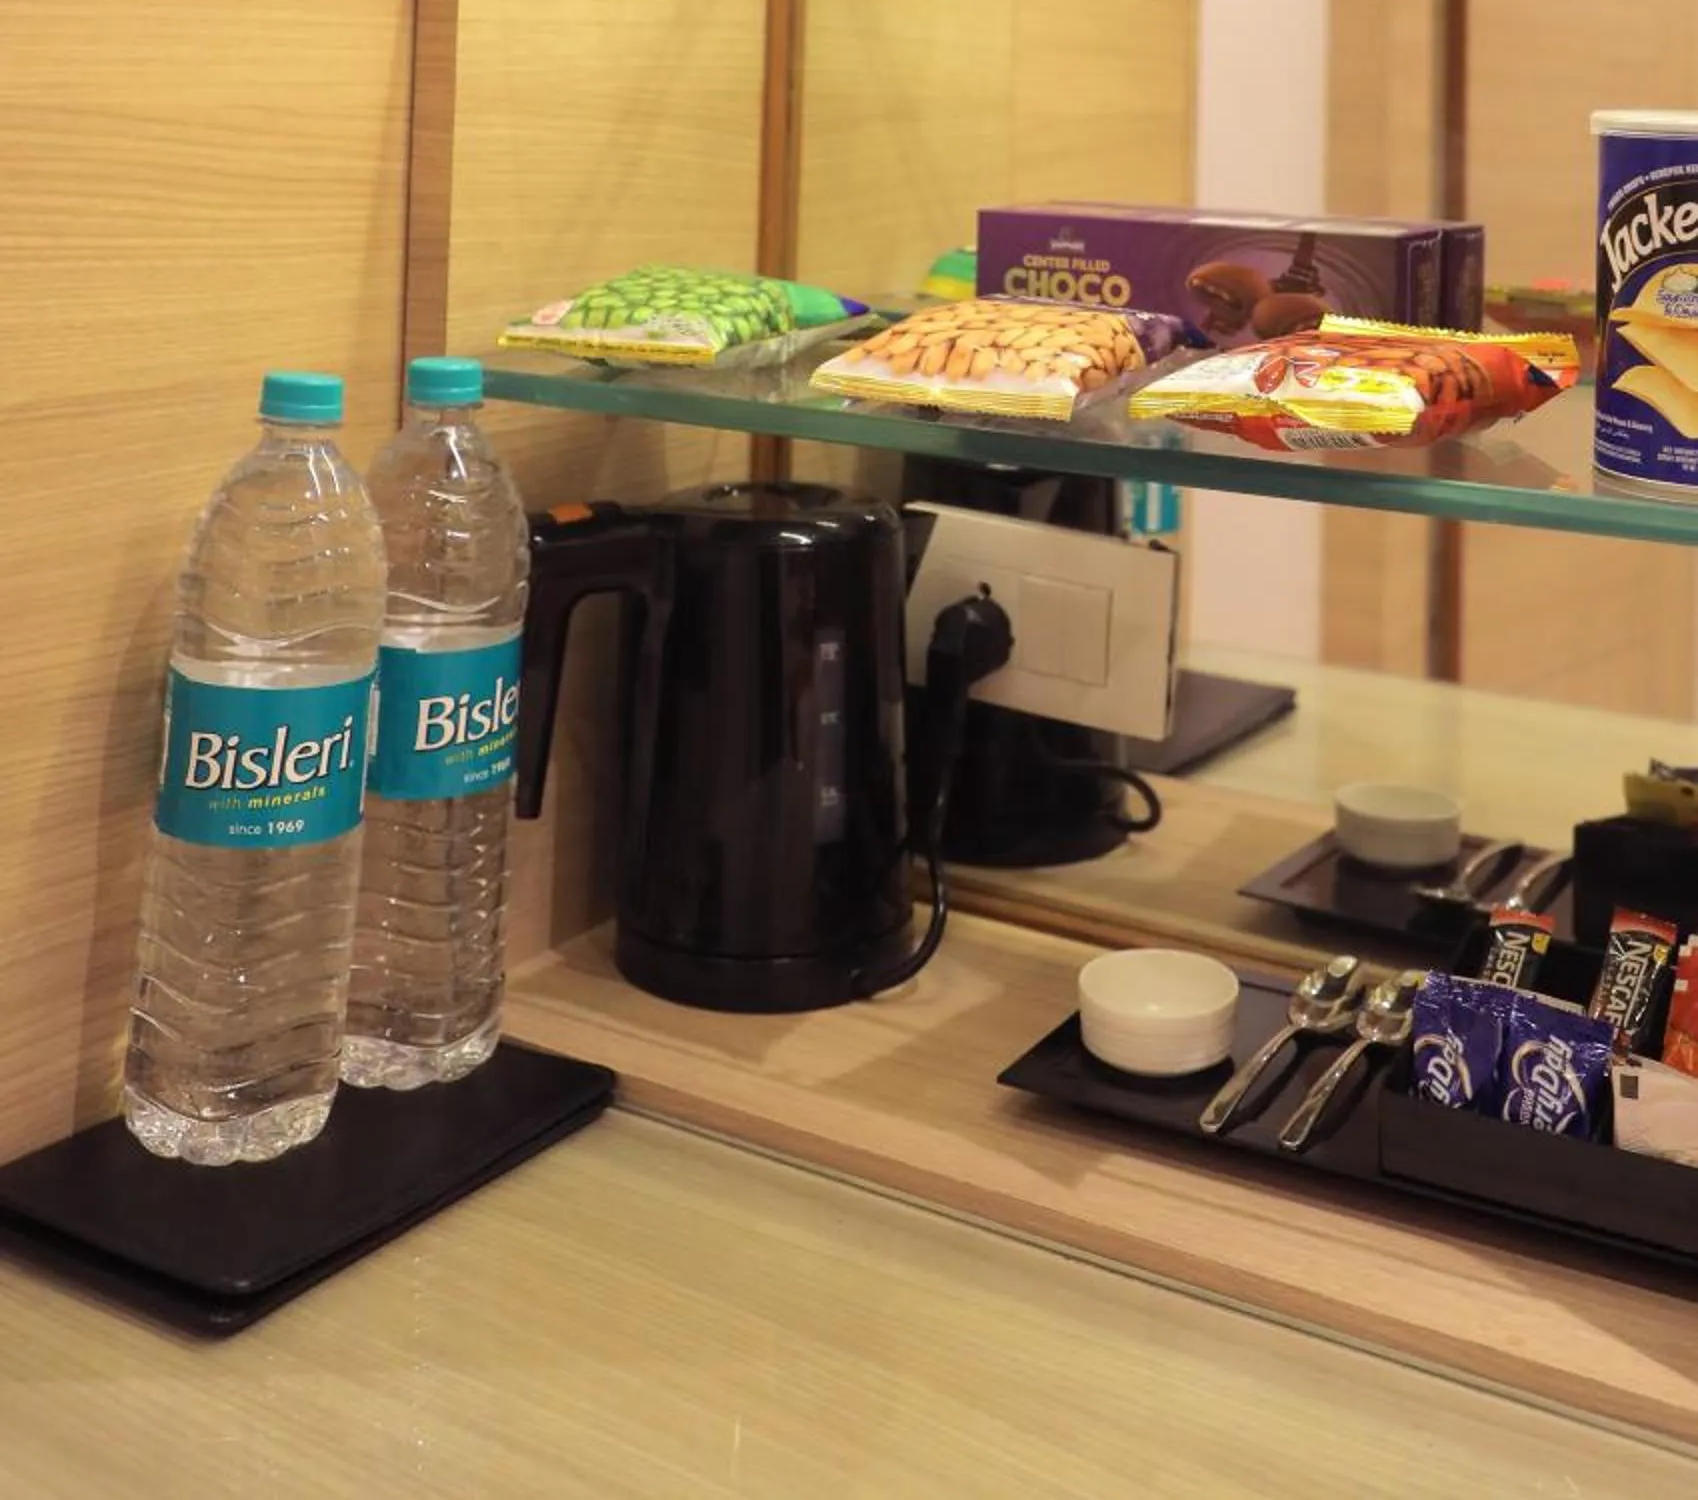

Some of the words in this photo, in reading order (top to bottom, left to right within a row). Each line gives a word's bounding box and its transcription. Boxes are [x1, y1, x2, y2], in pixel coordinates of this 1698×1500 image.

[1023, 255, 1069, 268] CENTER
[1072, 259, 1110, 273] FILLED
[1600, 193, 1698, 294] Jacke
[1004, 266, 1131, 307] CHOCO
[415, 676, 519, 753] Bisle
[184, 715, 353, 790] Bisleri
[208, 797, 241, 811] with
[247, 786, 326, 809] minerals
[228, 821, 261, 836] since
[268, 819, 305, 835] 1969
[1492, 931, 1531, 988] NESC
[1604, 940, 1653, 1029] NESCAF
